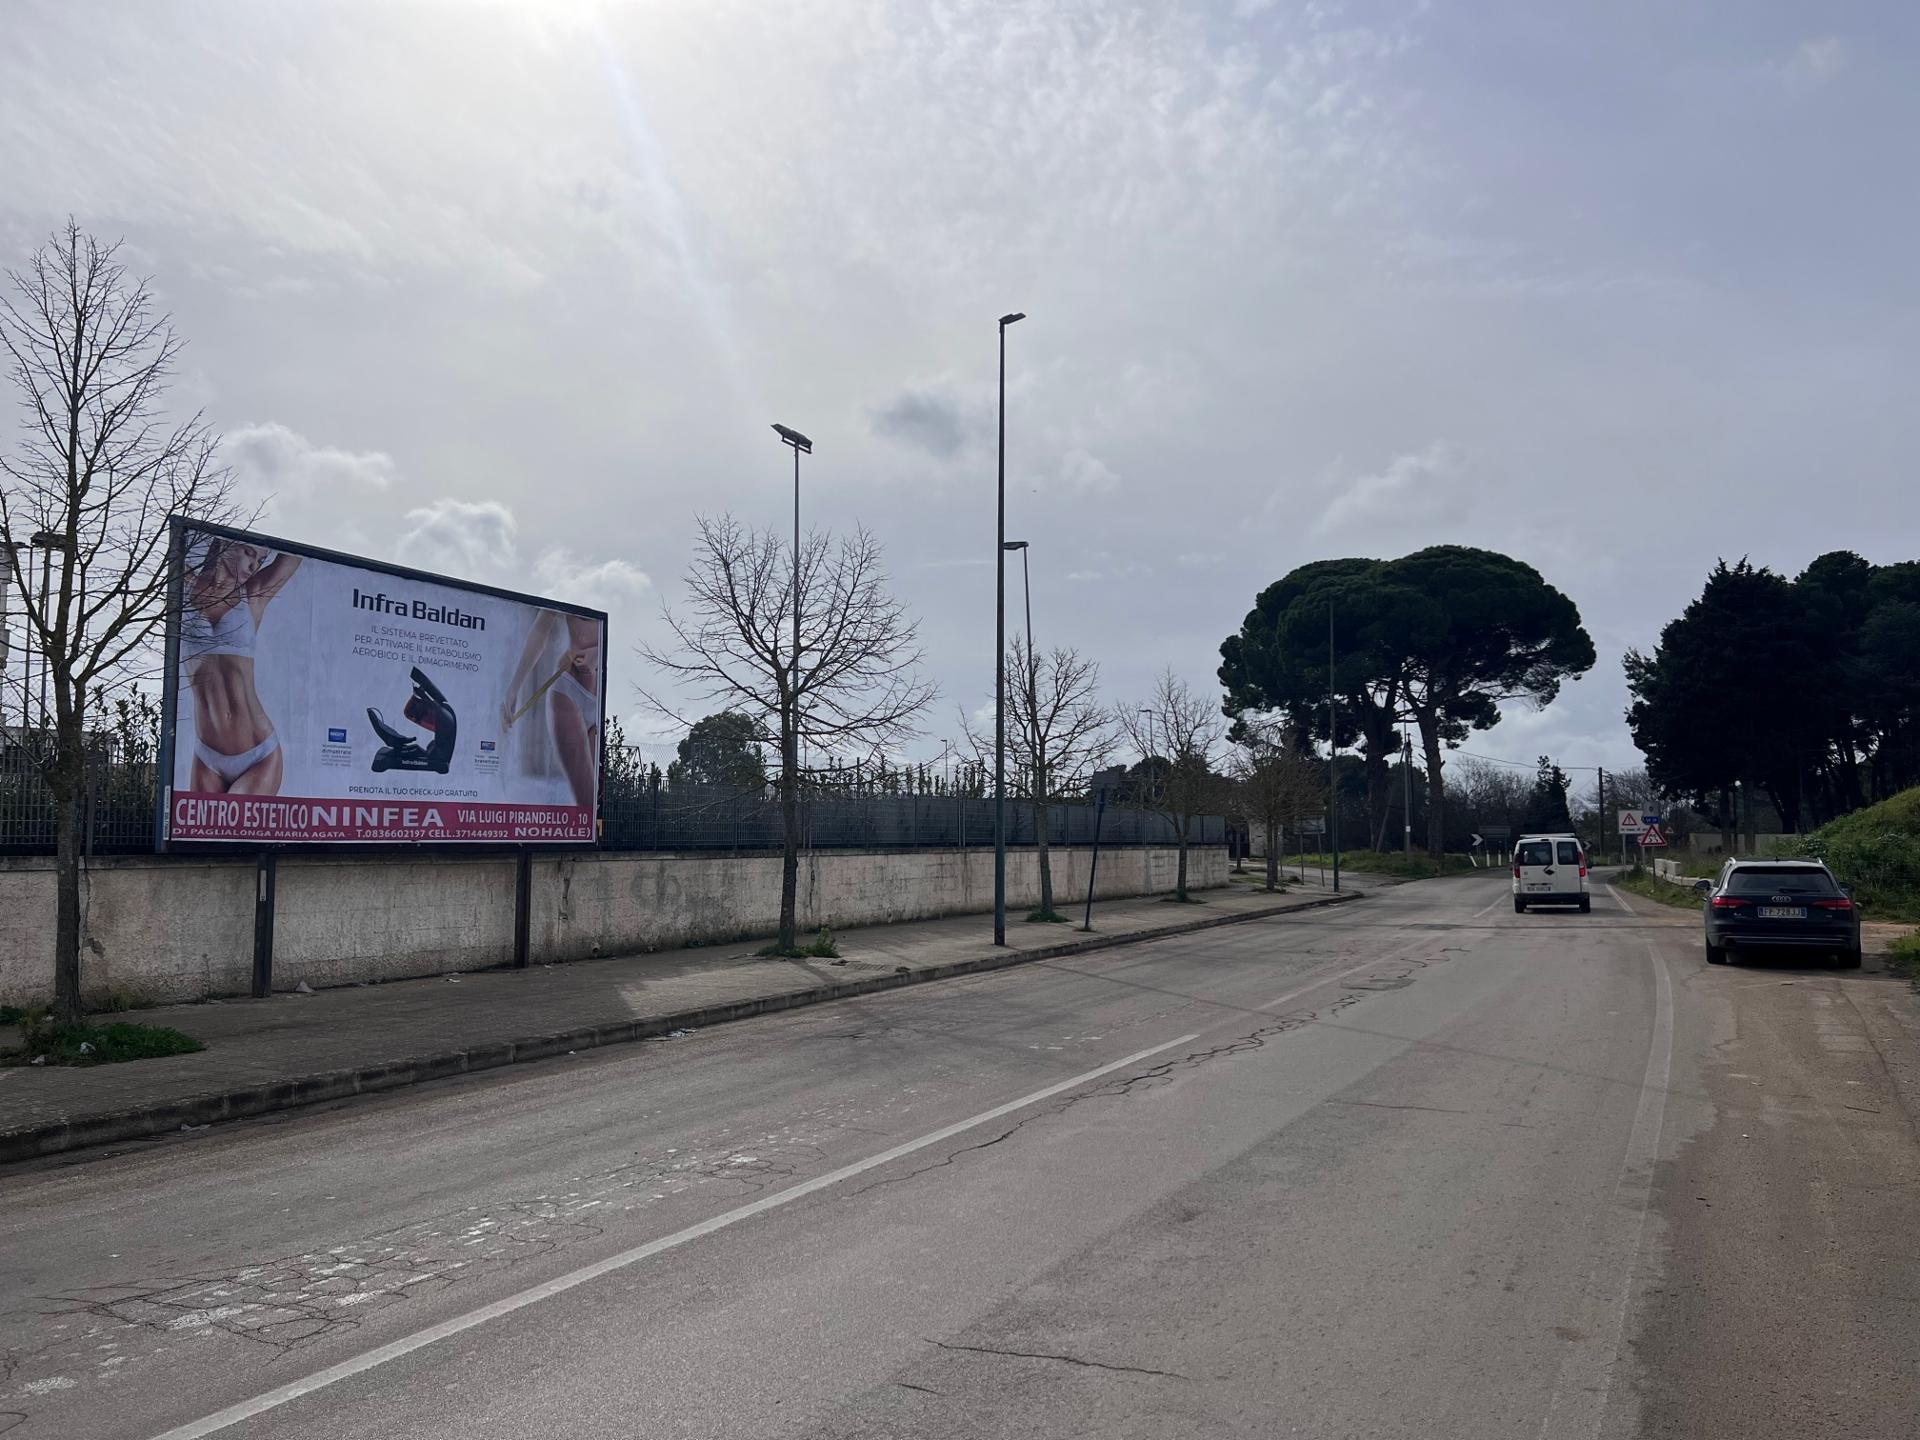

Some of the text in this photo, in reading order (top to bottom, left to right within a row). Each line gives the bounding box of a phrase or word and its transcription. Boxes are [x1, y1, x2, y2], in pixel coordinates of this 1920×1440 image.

[353, 589, 486, 631] Infra Baldan
[354, 634, 482, 662] PER ATTIVARE IL METABOLISMO
[371, 625, 469, 649] IL SISTEMA BREVETTATO
[352, 647, 479, 672] AEROBICO E IL DIMAGRIMENTO
[349, 786, 384, 794] PRENOTA
[385, 787, 391, 795] IL
[409, 788, 444, 797] CHECK-UP
[445, 789, 478, 797] GRATUITO
[175, 798, 240, 827] CENTRO
[243, 800, 308, 830] ESTETICO
[311, 805, 445, 828] NINFEA
[457, 809, 477, 823] VIA
[479, 810, 506, 824] LUIGI
[509, 810, 569, 825] PIRANDELLO
[578, 814, 588, 825] 10
[172, 827, 187, 835] DI
[190, 828, 271, 837] PAGLIALONGA
[514, 826, 591, 838] NOHA(LE)
